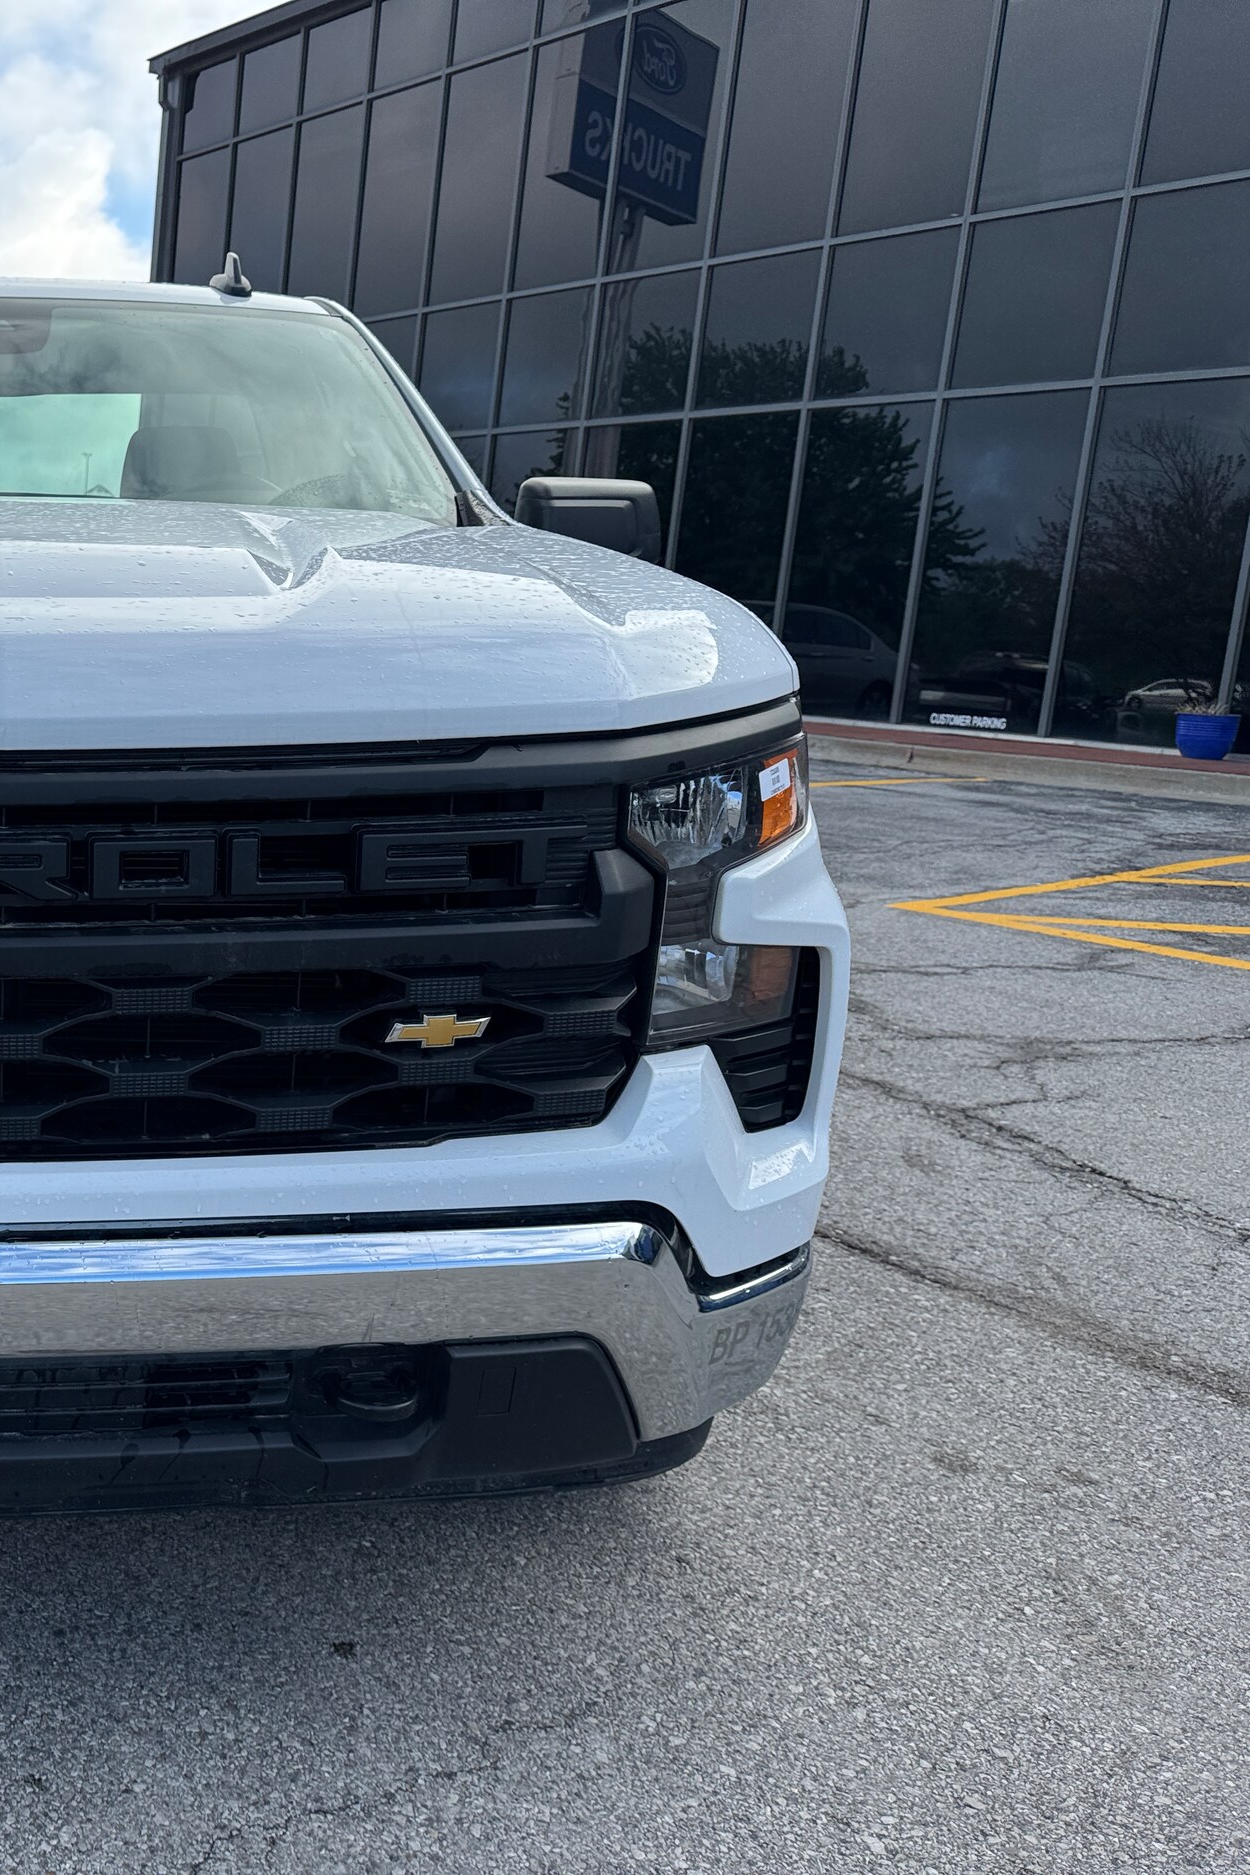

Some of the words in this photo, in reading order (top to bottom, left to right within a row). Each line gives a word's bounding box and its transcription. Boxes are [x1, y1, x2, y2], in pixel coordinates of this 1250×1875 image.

[930, 712, 972, 727] CUSTOMER
[972, 716, 1007, 730] PARKING
[708, 1319, 750, 1366] BP
